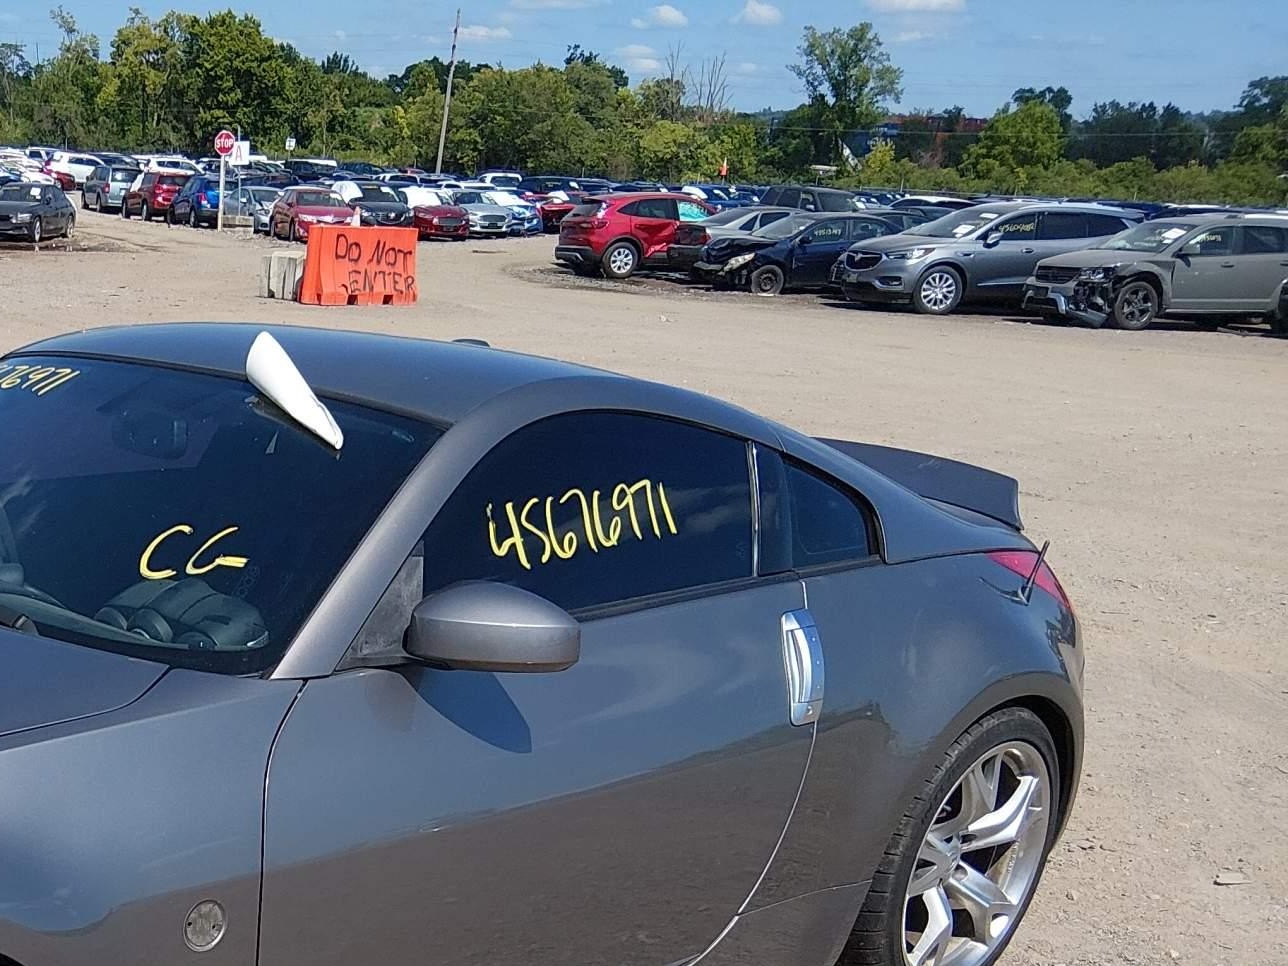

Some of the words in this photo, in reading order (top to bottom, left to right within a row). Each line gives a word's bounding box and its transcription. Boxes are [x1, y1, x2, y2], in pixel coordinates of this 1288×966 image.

[216, 138, 234, 149] STOP
[235, 144, 243, 161] A
[334, 233, 362, 263] DO
[368, 239, 413, 274] NOT
[349, 269, 416, 296] ENTER
[486, 478, 679, 570] 45676971
[139, 523, 250, 580] CG
